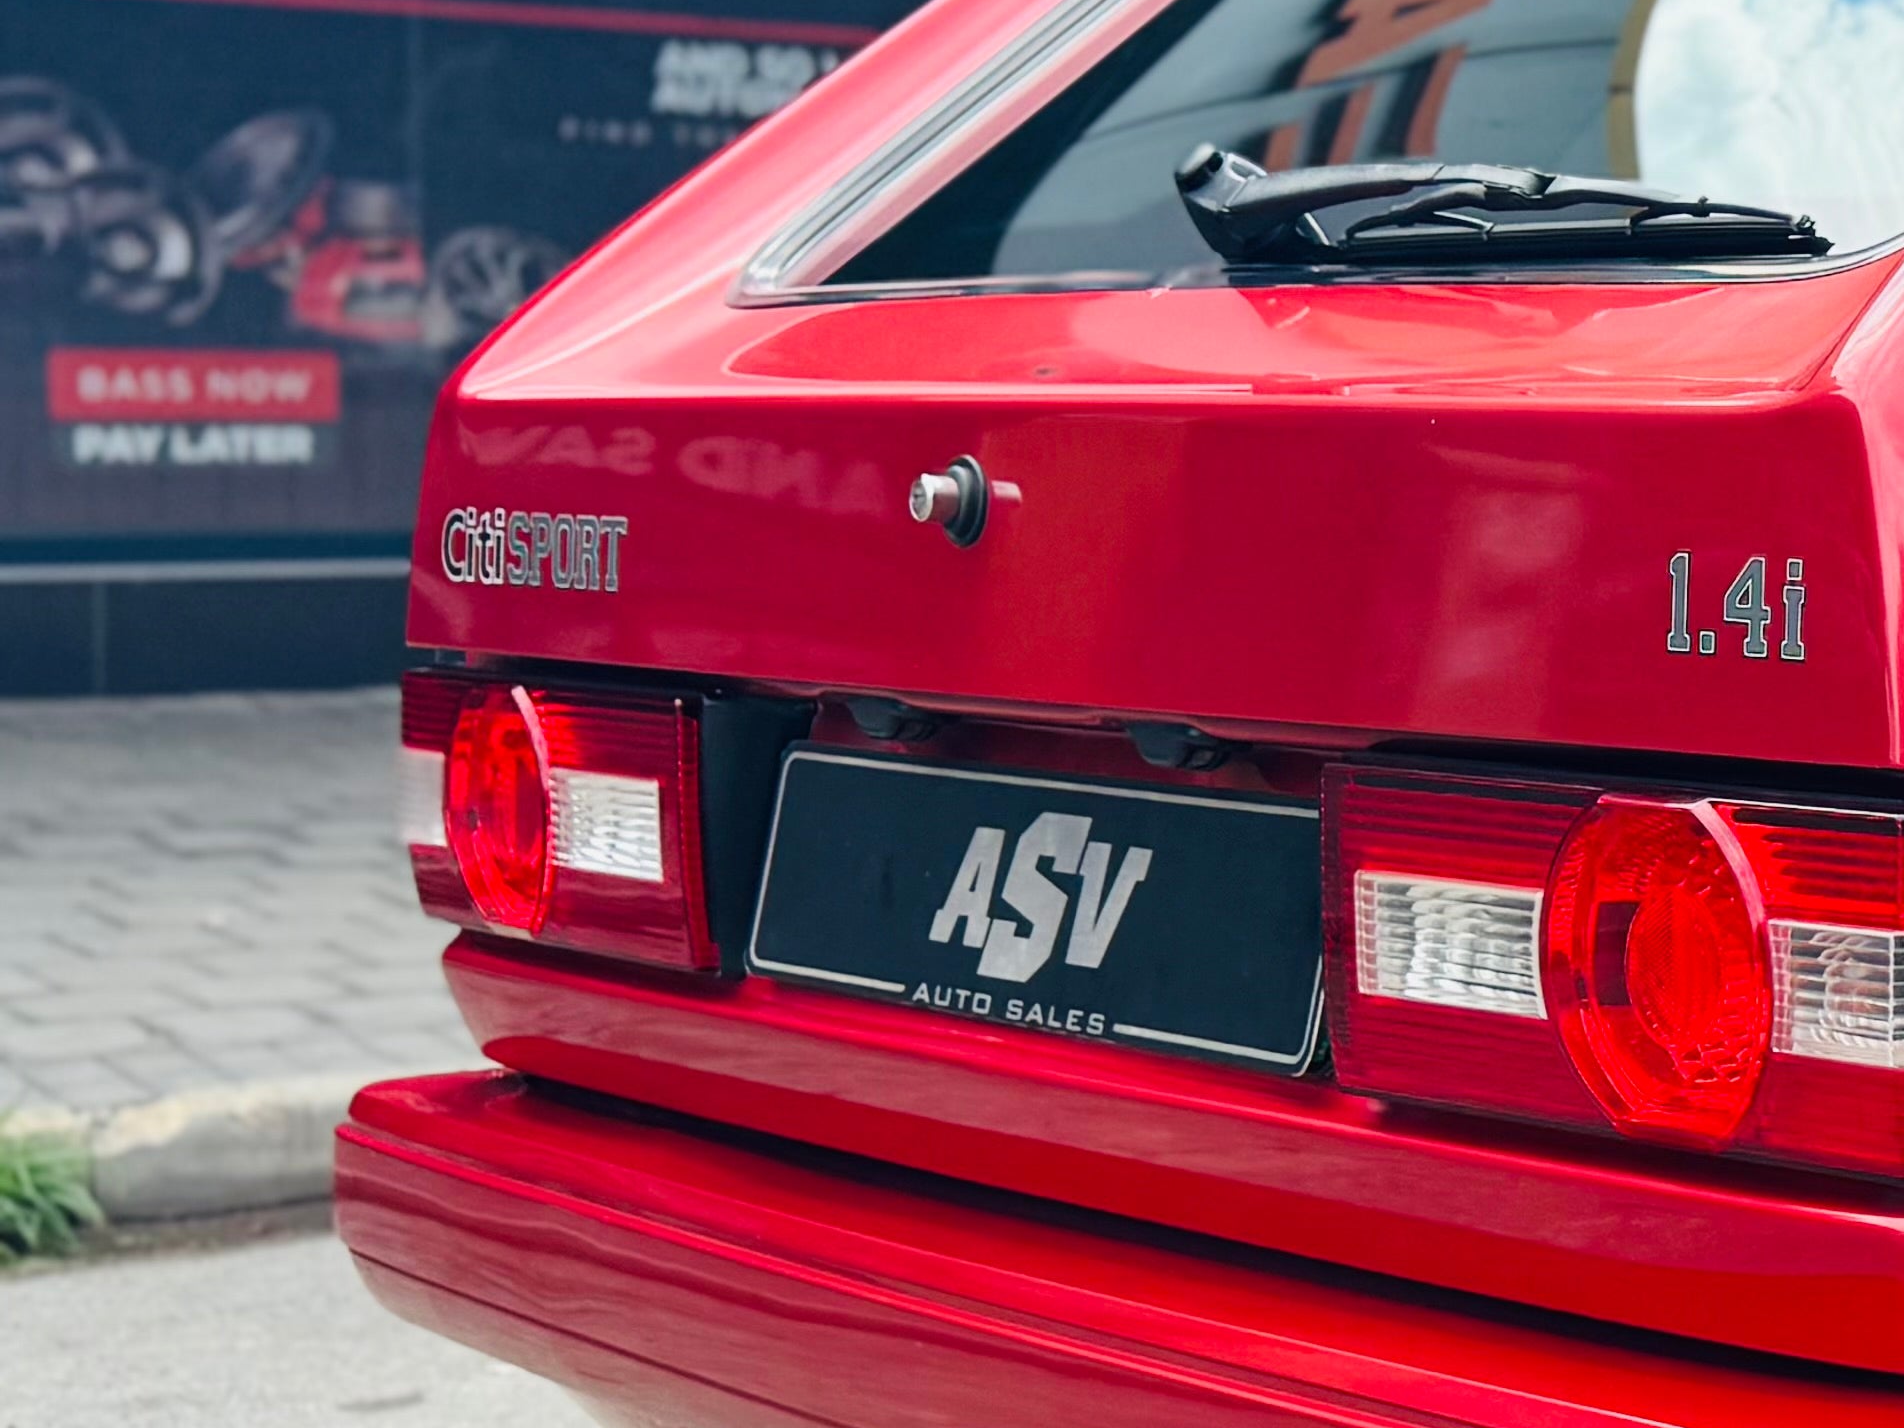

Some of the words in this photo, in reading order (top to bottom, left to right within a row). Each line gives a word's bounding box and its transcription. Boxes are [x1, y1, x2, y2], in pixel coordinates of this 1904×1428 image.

[77, 365, 193, 403] BASS
[206, 368, 313, 403] NOW
[72, 423, 163, 465] PAY
[170, 423, 314, 465] LATER
[1666, 552, 1805, 661] 1.4i
[929, 810, 1153, 983] ASV
[911, 981, 992, 1016] AUTO
[1004, 998, 1106, 1037] SALES
